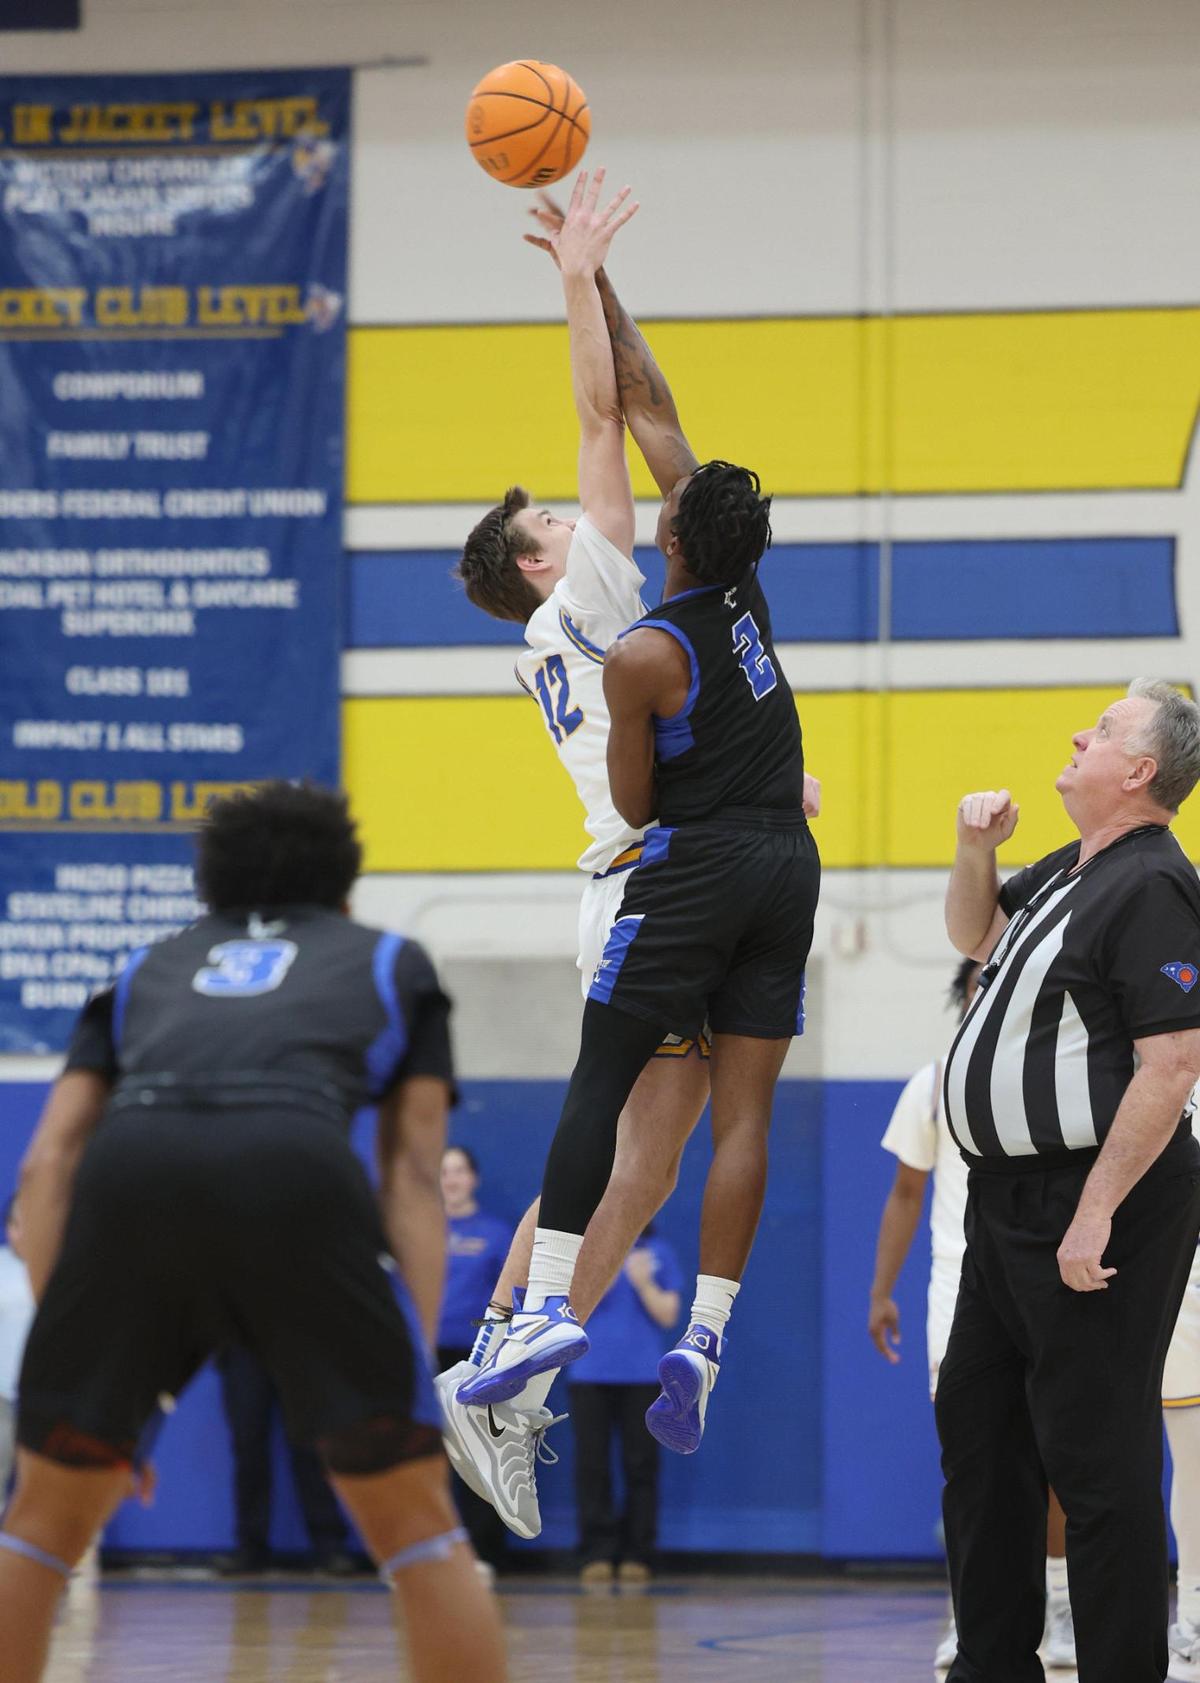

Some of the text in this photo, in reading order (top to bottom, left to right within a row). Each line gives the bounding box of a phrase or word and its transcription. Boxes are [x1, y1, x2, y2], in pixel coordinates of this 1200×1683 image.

[59, 102, 199, 142] JACKET
[95, 286, 190, 325] CLUB
[197, 285, 307, 325] LEVEL
[53, 369, 204, 400] COMPORIUM
[47, 430, 210, 460] FAMILY TRUST
[62, 488, 161, 518] FEDERAL
[163, 488, 246, 518] CREDIT
[249, 488, 327, 518] UNION
[95, 546, 271, 577] ORTHODONTICS
[94, 578, 164, 609] HOTEL
[192, 578, 301, 609] DAYCARE
[731, 610, 778, 702] 2
[65, 665, 142, 697] CLASS
[534, 653, 584, 746] 12
[13, 719, 103, 750] IMPACT
[123, 721, 165, 752] ALL
[167, 722, 244, 754] STARS
[70, 779, 163, 820] CLUB
